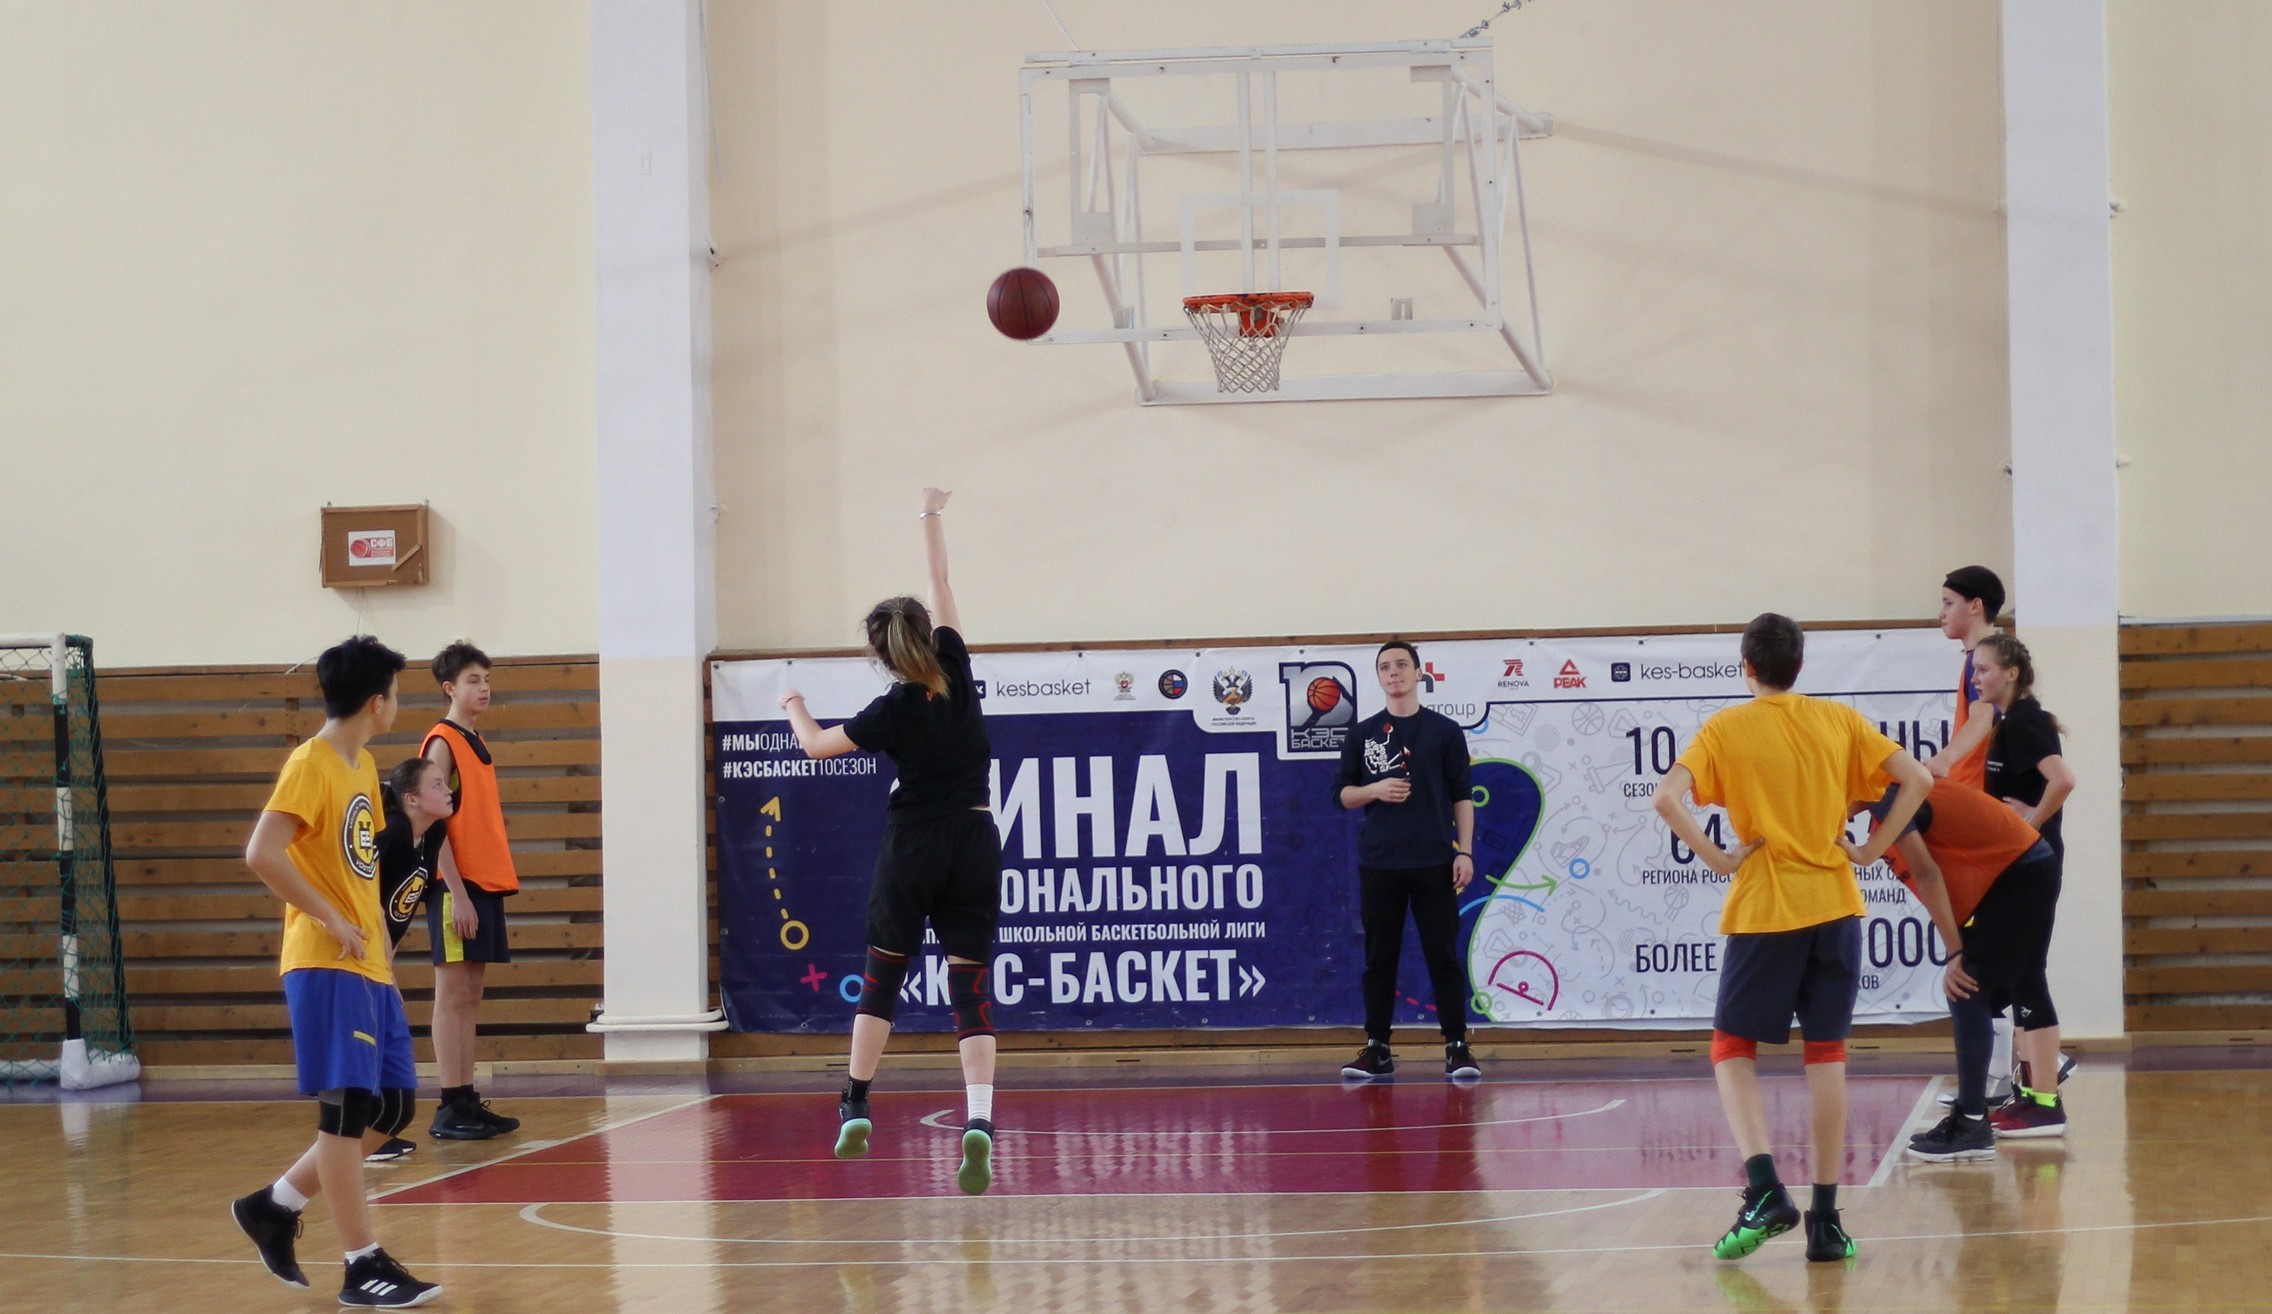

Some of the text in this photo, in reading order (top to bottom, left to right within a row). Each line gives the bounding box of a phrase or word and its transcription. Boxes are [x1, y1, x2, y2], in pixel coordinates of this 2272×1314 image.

[1640, 661, 1743, 681] kes-basket
[996, 678, 1091, 697] kesbasket
[1497, 680, 1530, 688] RENOVA
[1553, 676, 1588, 689] PEAK
[722, 732, 804, 752] #МЫОДНА
[1291, 727, 1349, 738] КЭС
[1626, 726, 1676, 775] 10
[723, 757, 877, 779] #КЭСБАСКЕТ10СЕЗОН
[1623, 782, 1657, 798] СЕЗО
[987, 752, 1263, 859] ИНАЛ
[1642, 869, 1698, 885] РЕГИОНА
[1855, 866, 1883, 881] НЫХ
[1000, 863, 1264, 914] ОНАЛЬНОГО
[1861, 887, 1907, 904] ОМАНД
[1000, 919, 1266, 943] ШКОЛЬНОЙ БАСКЕТБОЛЬНОЙ ЛИГИ
[1636, 943, 1717, 973] БОЛЕЕ
[900, 949, 1266, 1007] «КС-БАСКЕТ»
